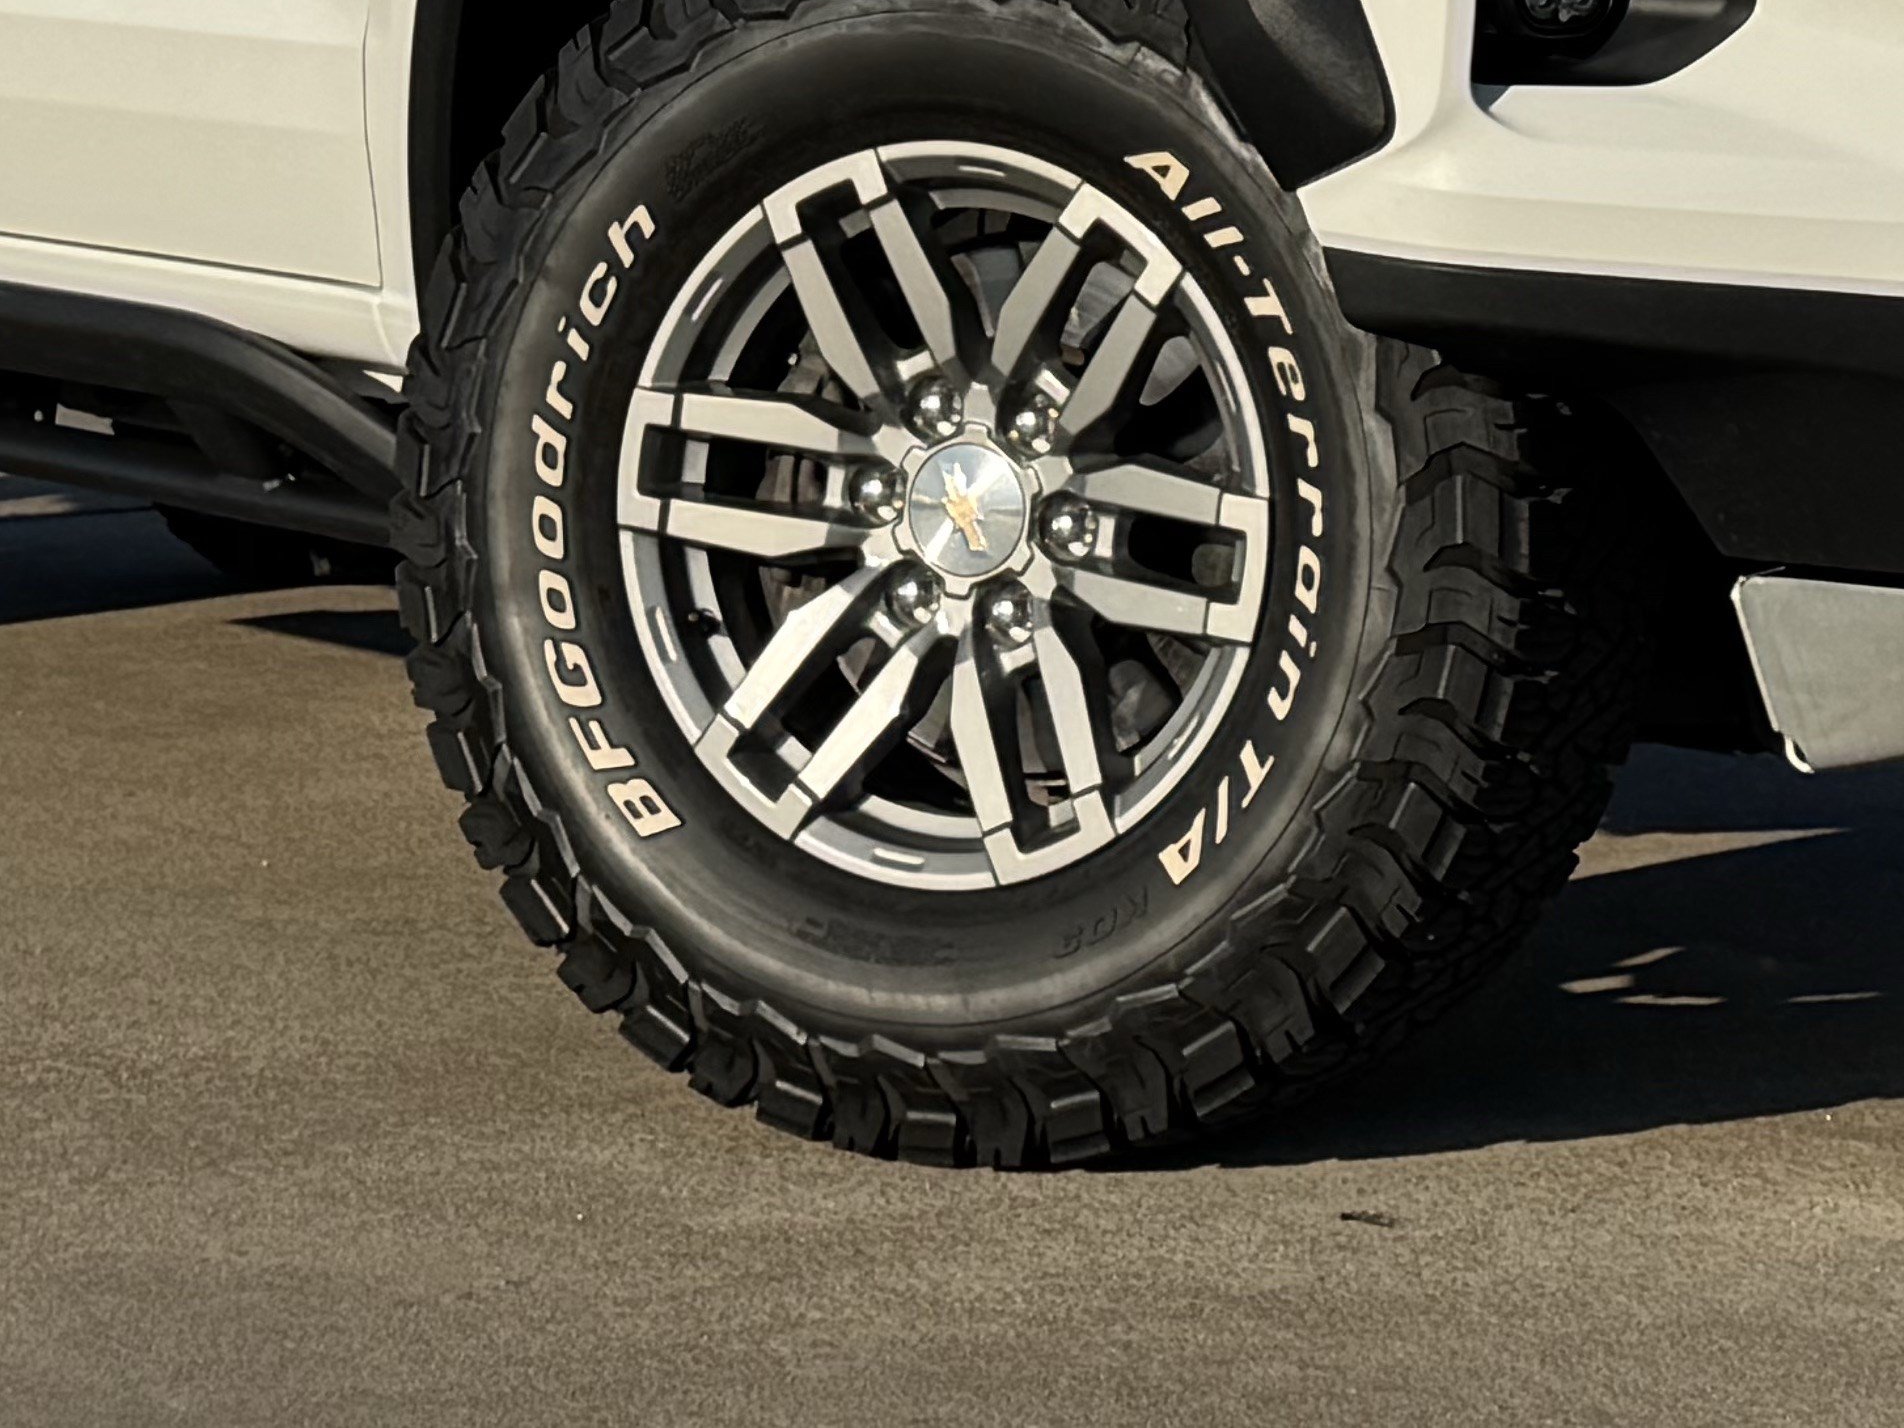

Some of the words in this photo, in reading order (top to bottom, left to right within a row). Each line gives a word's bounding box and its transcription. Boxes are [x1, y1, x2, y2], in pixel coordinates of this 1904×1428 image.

[531, 204, 683, 838] BFGoodrich
[1123, 151, 1322, 721] All-Terrain
[1158, 740, 1274, 884] T/A
